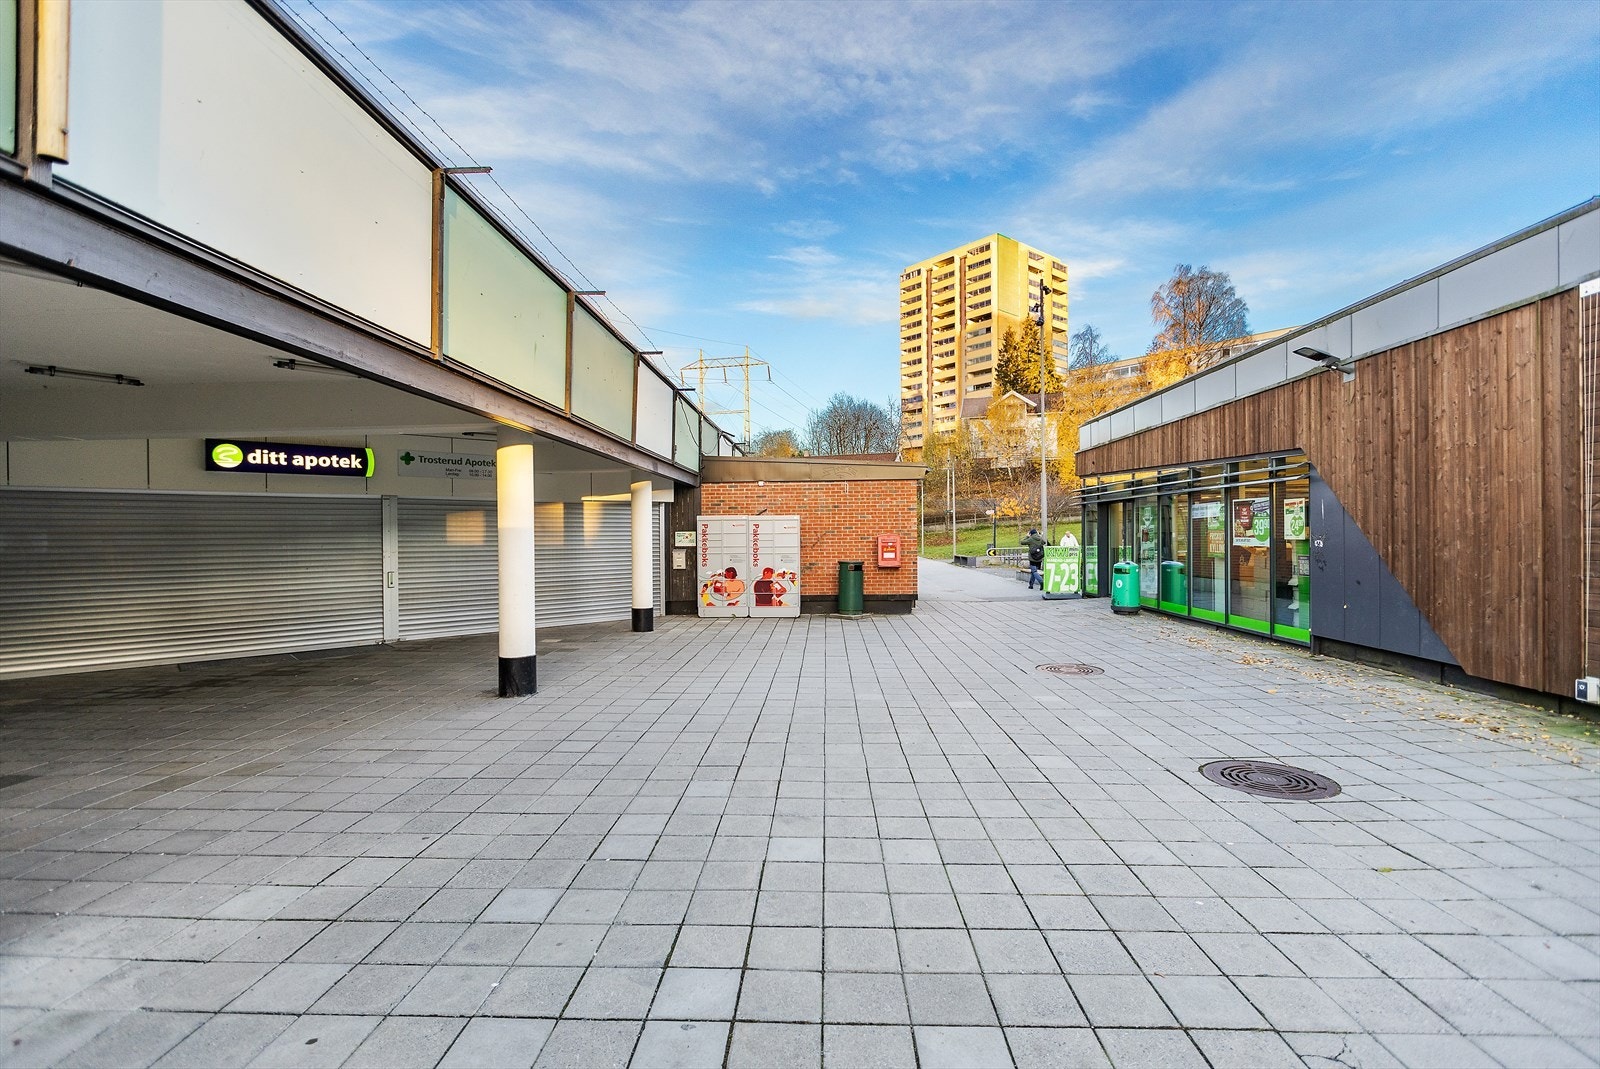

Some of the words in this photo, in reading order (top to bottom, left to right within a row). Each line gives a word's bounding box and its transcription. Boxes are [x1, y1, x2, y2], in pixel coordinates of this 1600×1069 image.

[247, 449, 288, 466] ditt
[292, 454, 363, 470] apotek
[418, 455, 463, 466] Trosterud
[465, 458, 496, 467] Apotek
[1046, 547, 1069, 558] KIWI
[1046, 562, 1078, 591] 7-23
